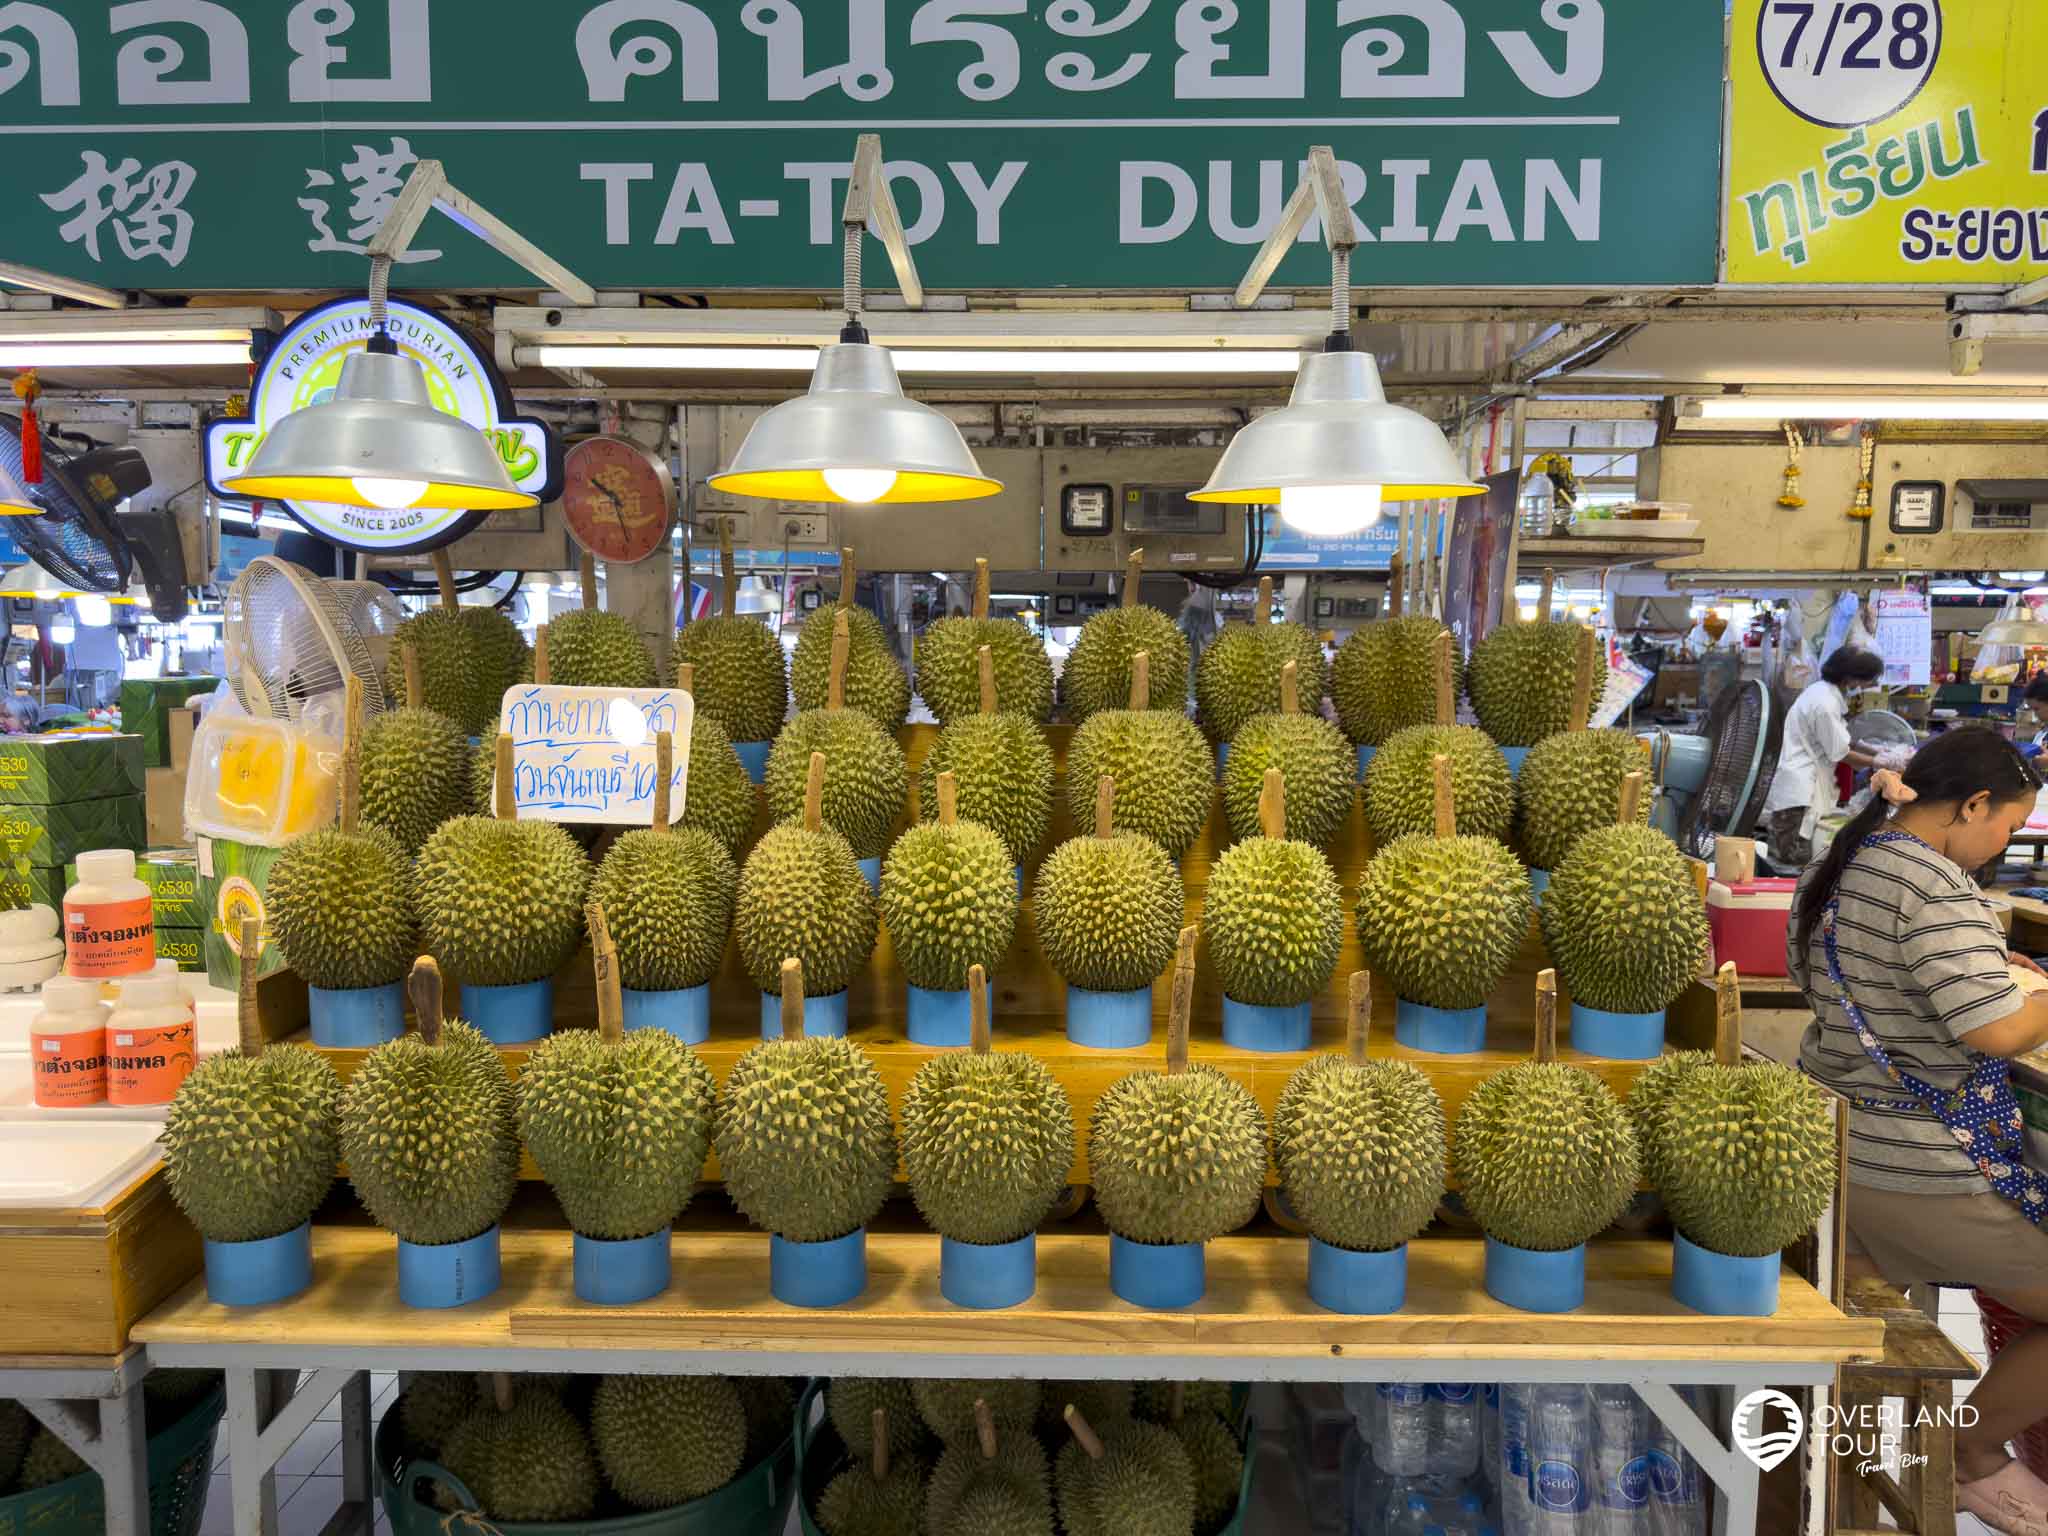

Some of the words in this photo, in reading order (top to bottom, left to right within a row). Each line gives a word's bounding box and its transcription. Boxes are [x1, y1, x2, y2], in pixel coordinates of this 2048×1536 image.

[1774, 2, 1929, 76] 7/28
[580, 160, 1028, 246] TA-TOY
[1119, 158, 1602, 245] DURIAN
[1744, 106, 1984, 266] ทุเรียน
[280, 317, 377, 380] PREMIUM
[389, 320, 468, 379] DURIAN
[341, 513, 385, 530] SINCE
[390, 512, 424, 530] 2005
